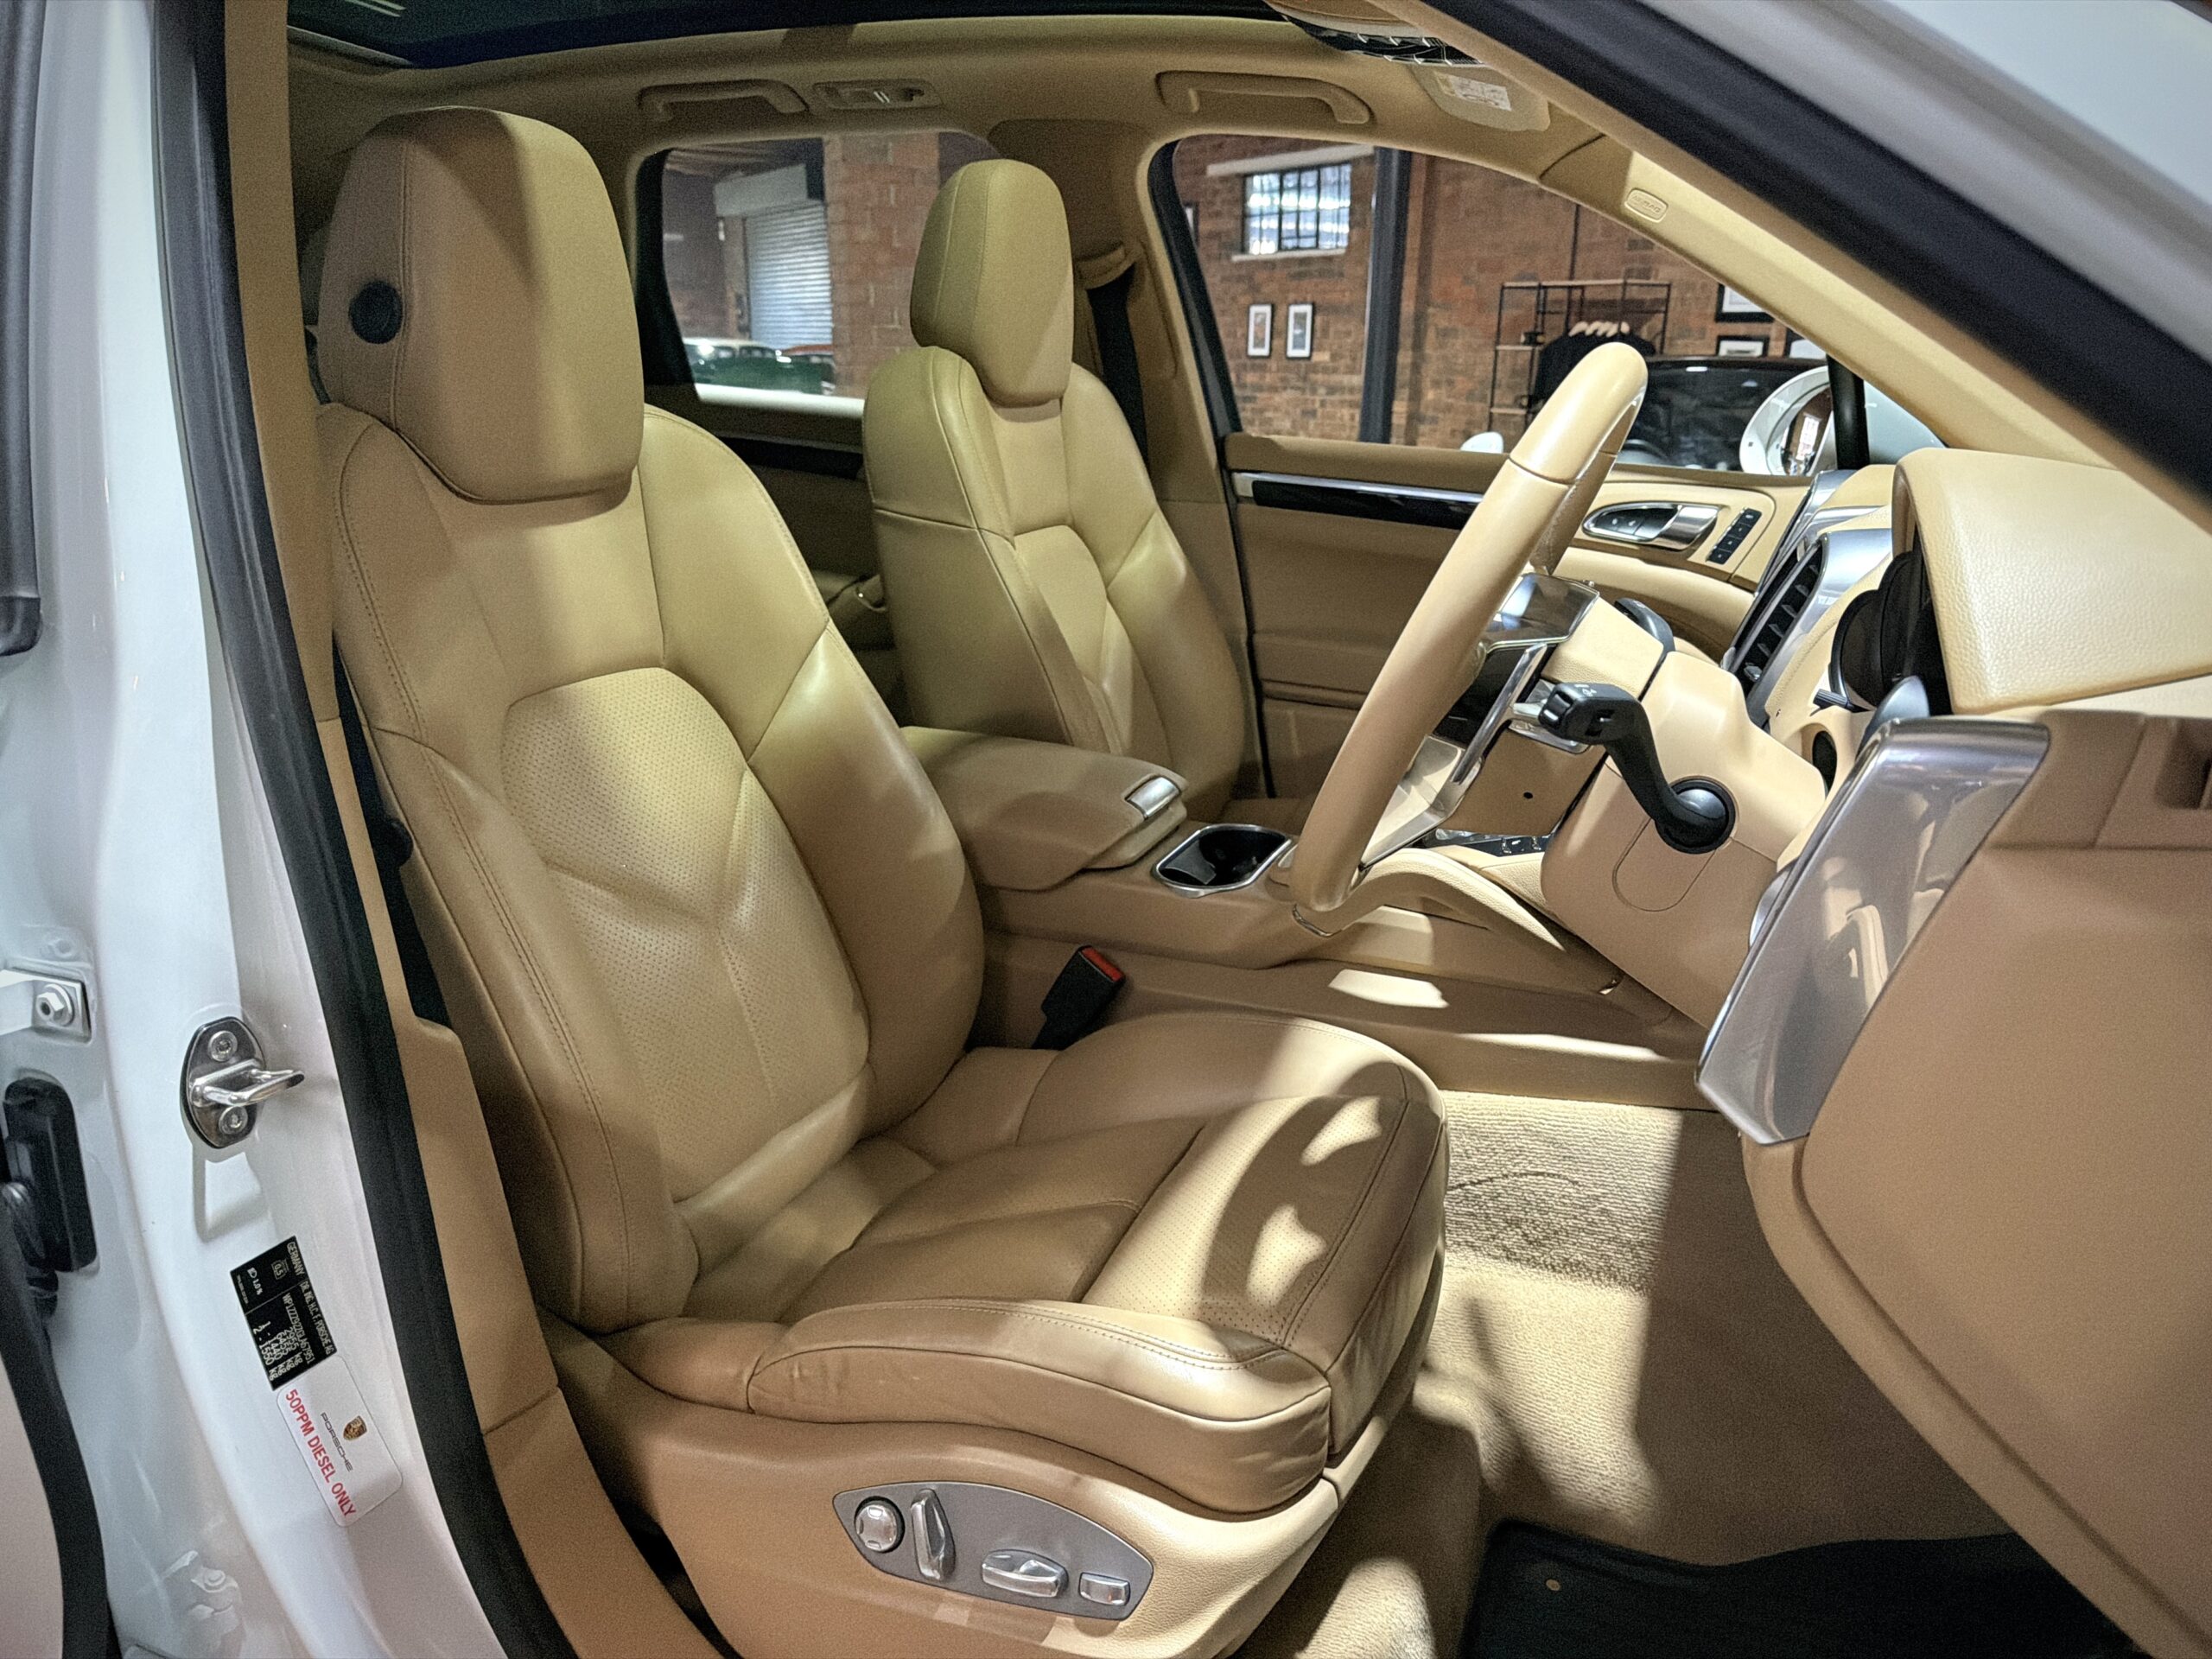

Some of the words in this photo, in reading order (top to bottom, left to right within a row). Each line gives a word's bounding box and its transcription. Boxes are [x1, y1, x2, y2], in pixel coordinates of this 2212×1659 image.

[287, 1242, 305, 1275] GERMANY
[252, 1325, 264, 1335] 2
[258, 1341, 275, 1365] 1550
[261, 1321, 271, 1330] 1
[267, 1336, 283, 1362] 1440
[276, 1332, 291, 1356] 6455
[283, 1326, 300, 1351] 2955
[286, 1389, 315, 1437] 50PPM
[308, 1435, 336, 1483] DIESEL
[332, 1483, 357, 1518] ONLY
[321, 1412, 353, 1472] PORSCHE
